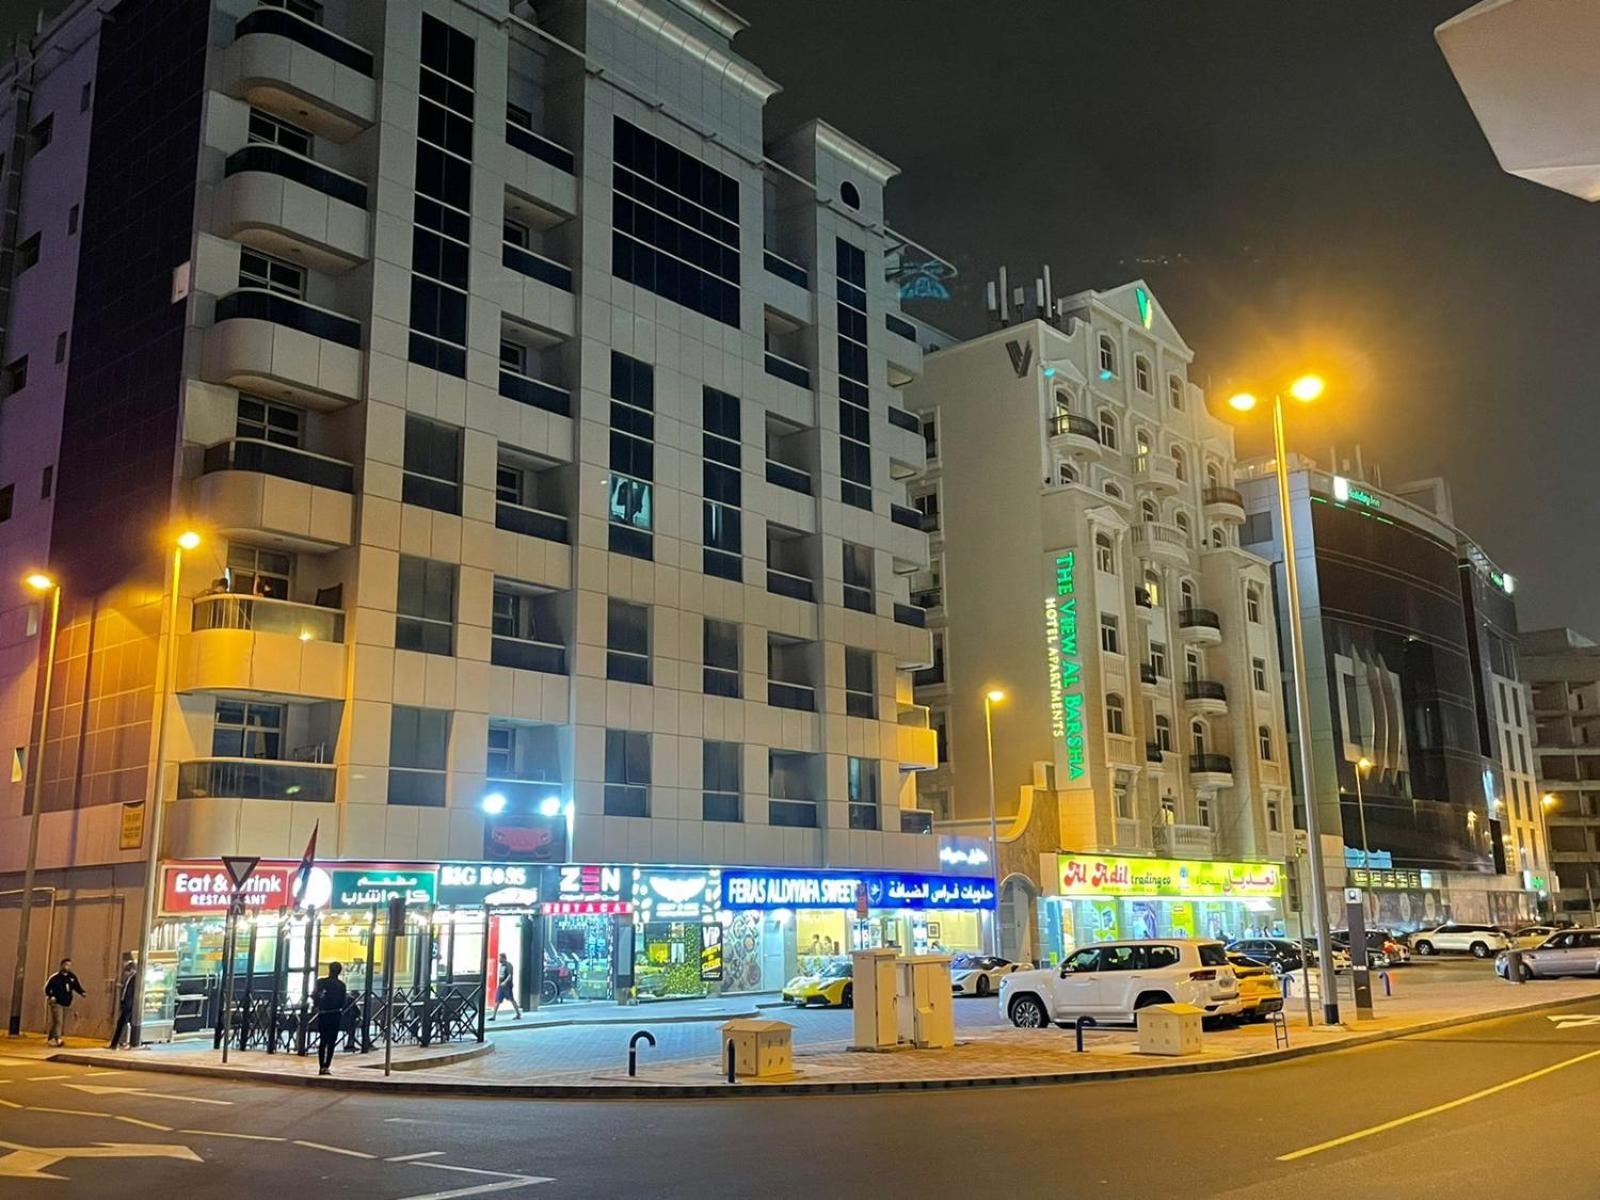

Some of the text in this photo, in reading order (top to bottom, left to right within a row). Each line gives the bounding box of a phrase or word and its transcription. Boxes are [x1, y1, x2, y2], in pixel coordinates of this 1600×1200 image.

[1045, 597, 1065, 737] HOTEL APARTMENTS
[1056, 551, 1085, 780] THE VIEW AL BARSHA
[175, 873, 212, 893] Eat
[440, 866, 527, 886] BIG BOSS
[560, 867, 620, 892] ZEN
[1064, 861, 1087, 887] Al
[1091, 862, 1129, 887] Adil
[728, 878, 766, 904] FERAS
[820, 879, 862, 904] SWEET
